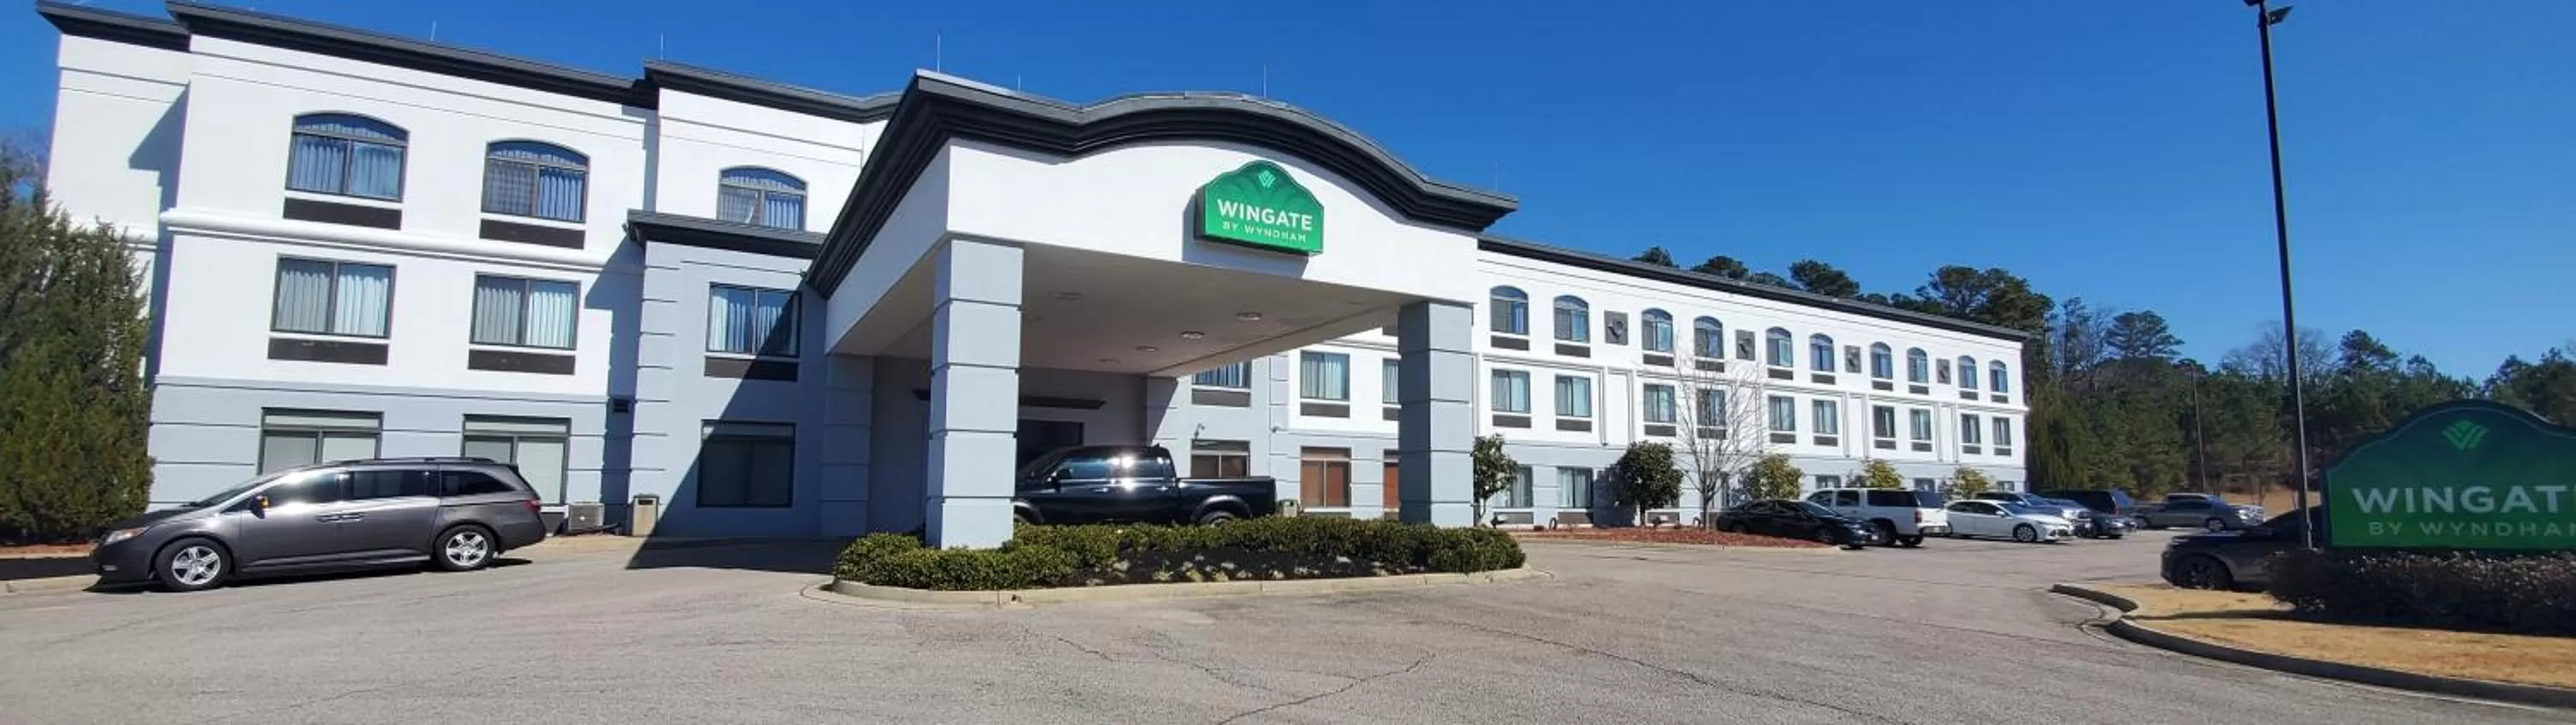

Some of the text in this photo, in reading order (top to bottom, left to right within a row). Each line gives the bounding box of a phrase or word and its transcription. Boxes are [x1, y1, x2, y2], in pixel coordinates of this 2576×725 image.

[1217, 198, 1313, 231] WINGATE
[1222, 221, 1306, 243] BY WYNDHAM
[2351, 484, 2576, 514] WINGAT
[2368, 521, 2403, 536] BY
